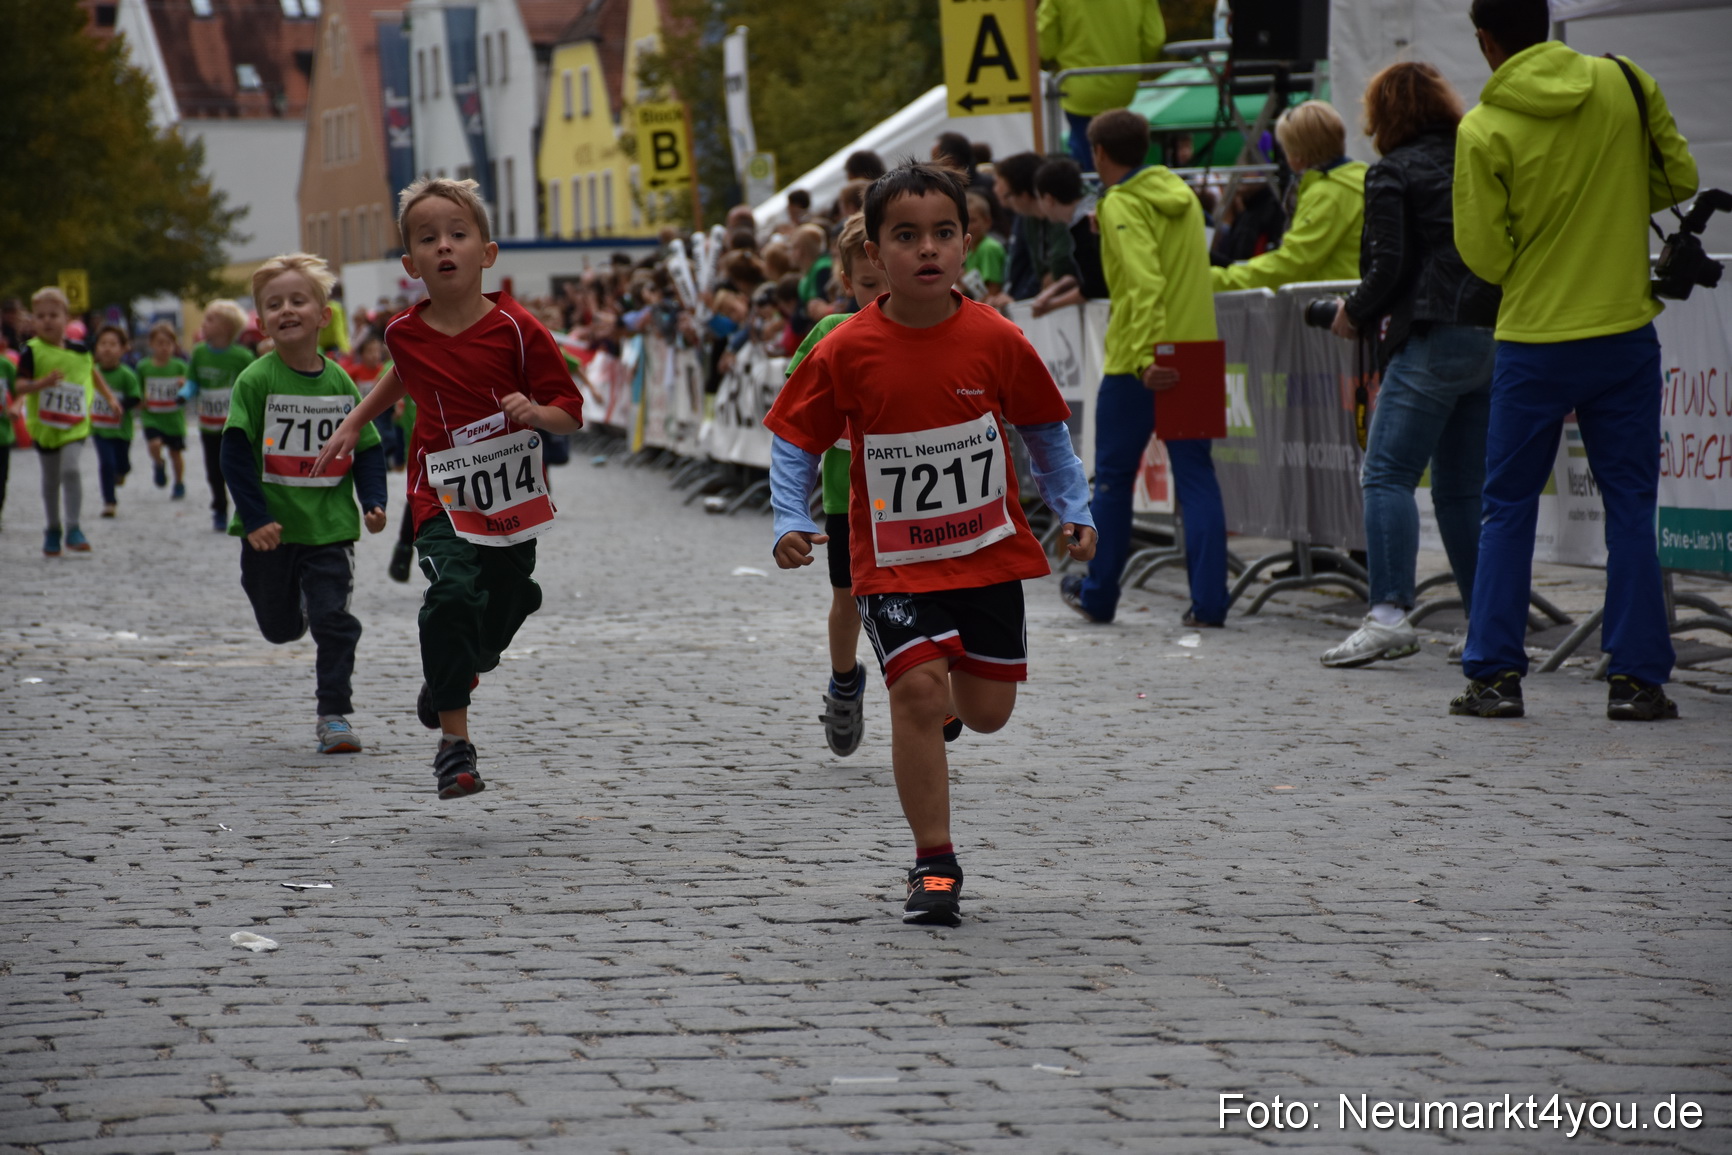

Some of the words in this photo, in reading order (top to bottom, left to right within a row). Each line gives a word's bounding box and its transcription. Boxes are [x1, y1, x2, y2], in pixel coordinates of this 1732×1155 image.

[966, 13, 1019, 84] A
[651, 130, 681, 171] B
[45, 391, 81, 412] 7155
[268, 403, 301, 414] PARTL
[303, 405, 343, 415] Neumarkt
[276, 417, 346, 452] 719
[467, 422, 491, 438] DEHN
[430, 457, 470, 474] PARTL
[472, 443, 524, 465] Neumarkt
[867, 446, 912, 460] PARTL
[915, 433, 982, 457] Neumarkt
[443, 455, 535, 511] 7014
[880, 448, 994, 513] 7217
[485, 515, 521, 533] Elias
[909, 513, 983, 545] Raphael
